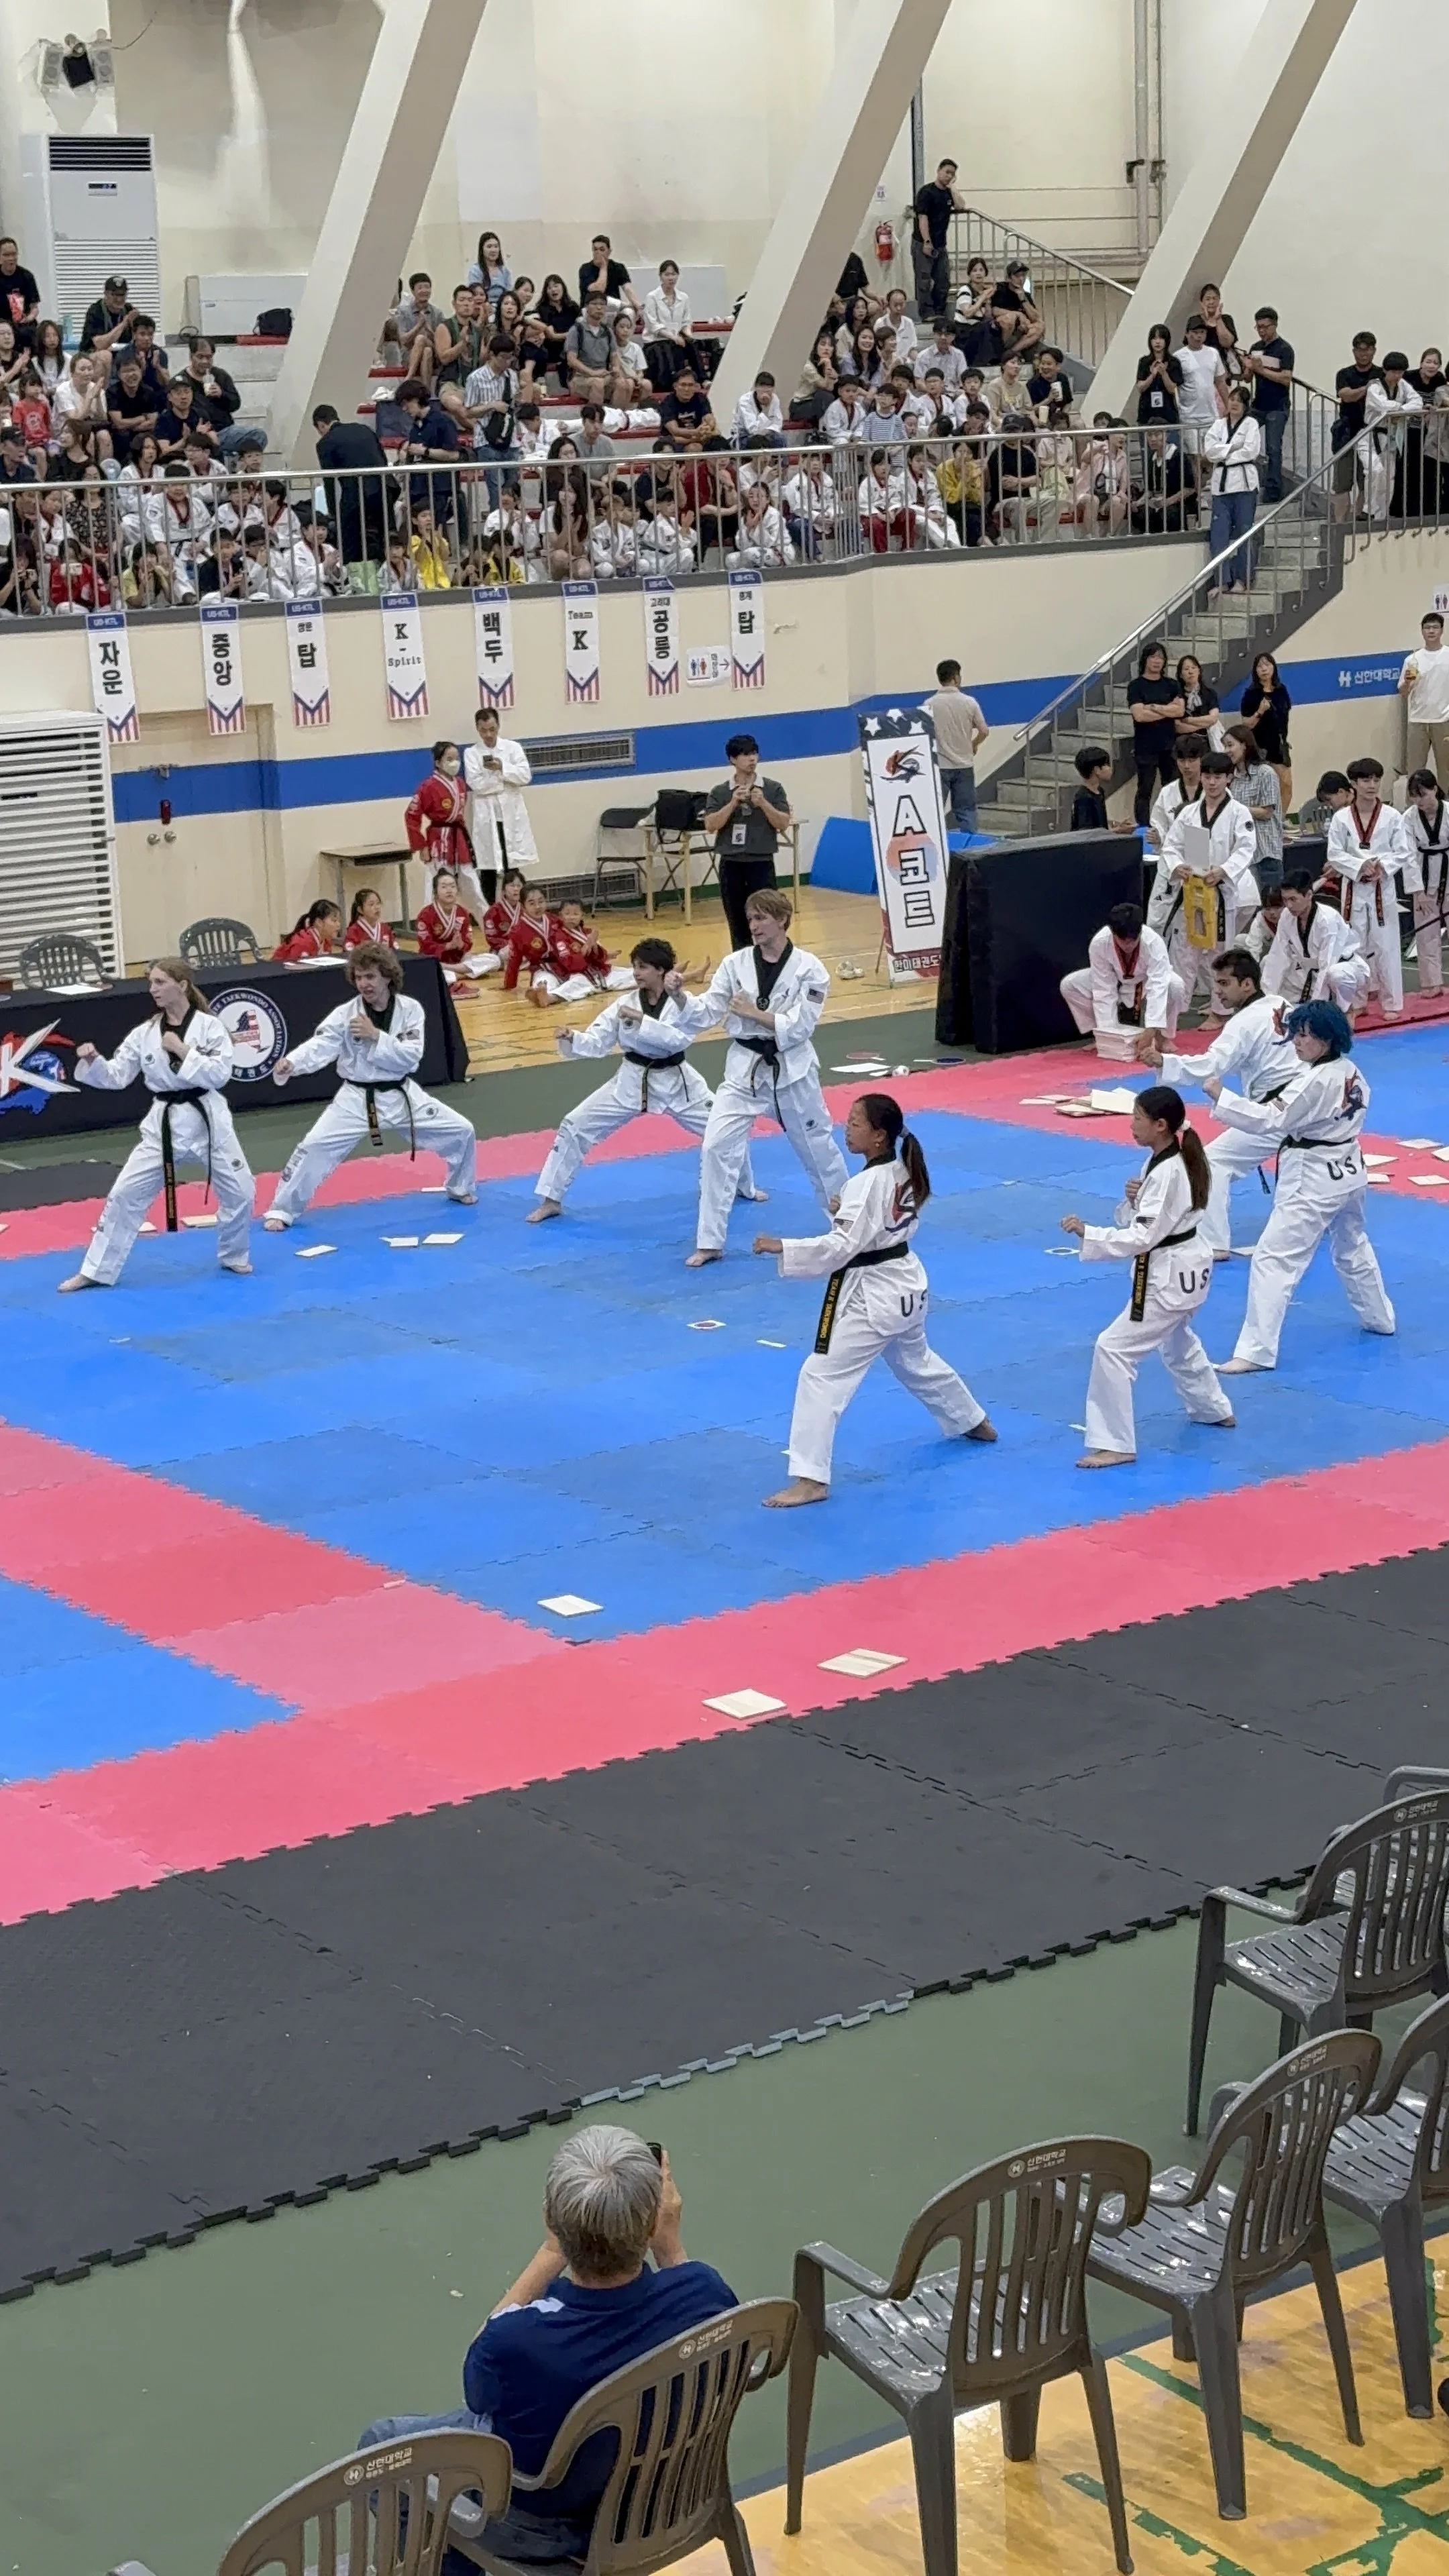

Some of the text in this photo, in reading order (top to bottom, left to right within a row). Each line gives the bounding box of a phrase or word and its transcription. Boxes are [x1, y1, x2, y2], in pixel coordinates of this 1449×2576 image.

[568, 610, 594, 620] Team
[738, 610, 755, 635] 탑
[394, 623, 409, 641] K
[482, 611, 504, 664] 백두
[572, 629, 589, 651] K
[652, 609, 669, 659] 공릉
[98, 640, 123, 696] 자운
[211, 633, 233, 687] 중앙
[297, 642, 318, 669] 탑
[388, 655, 422, 668] Spirit
[1327, 1150, 1365, 1181] US
